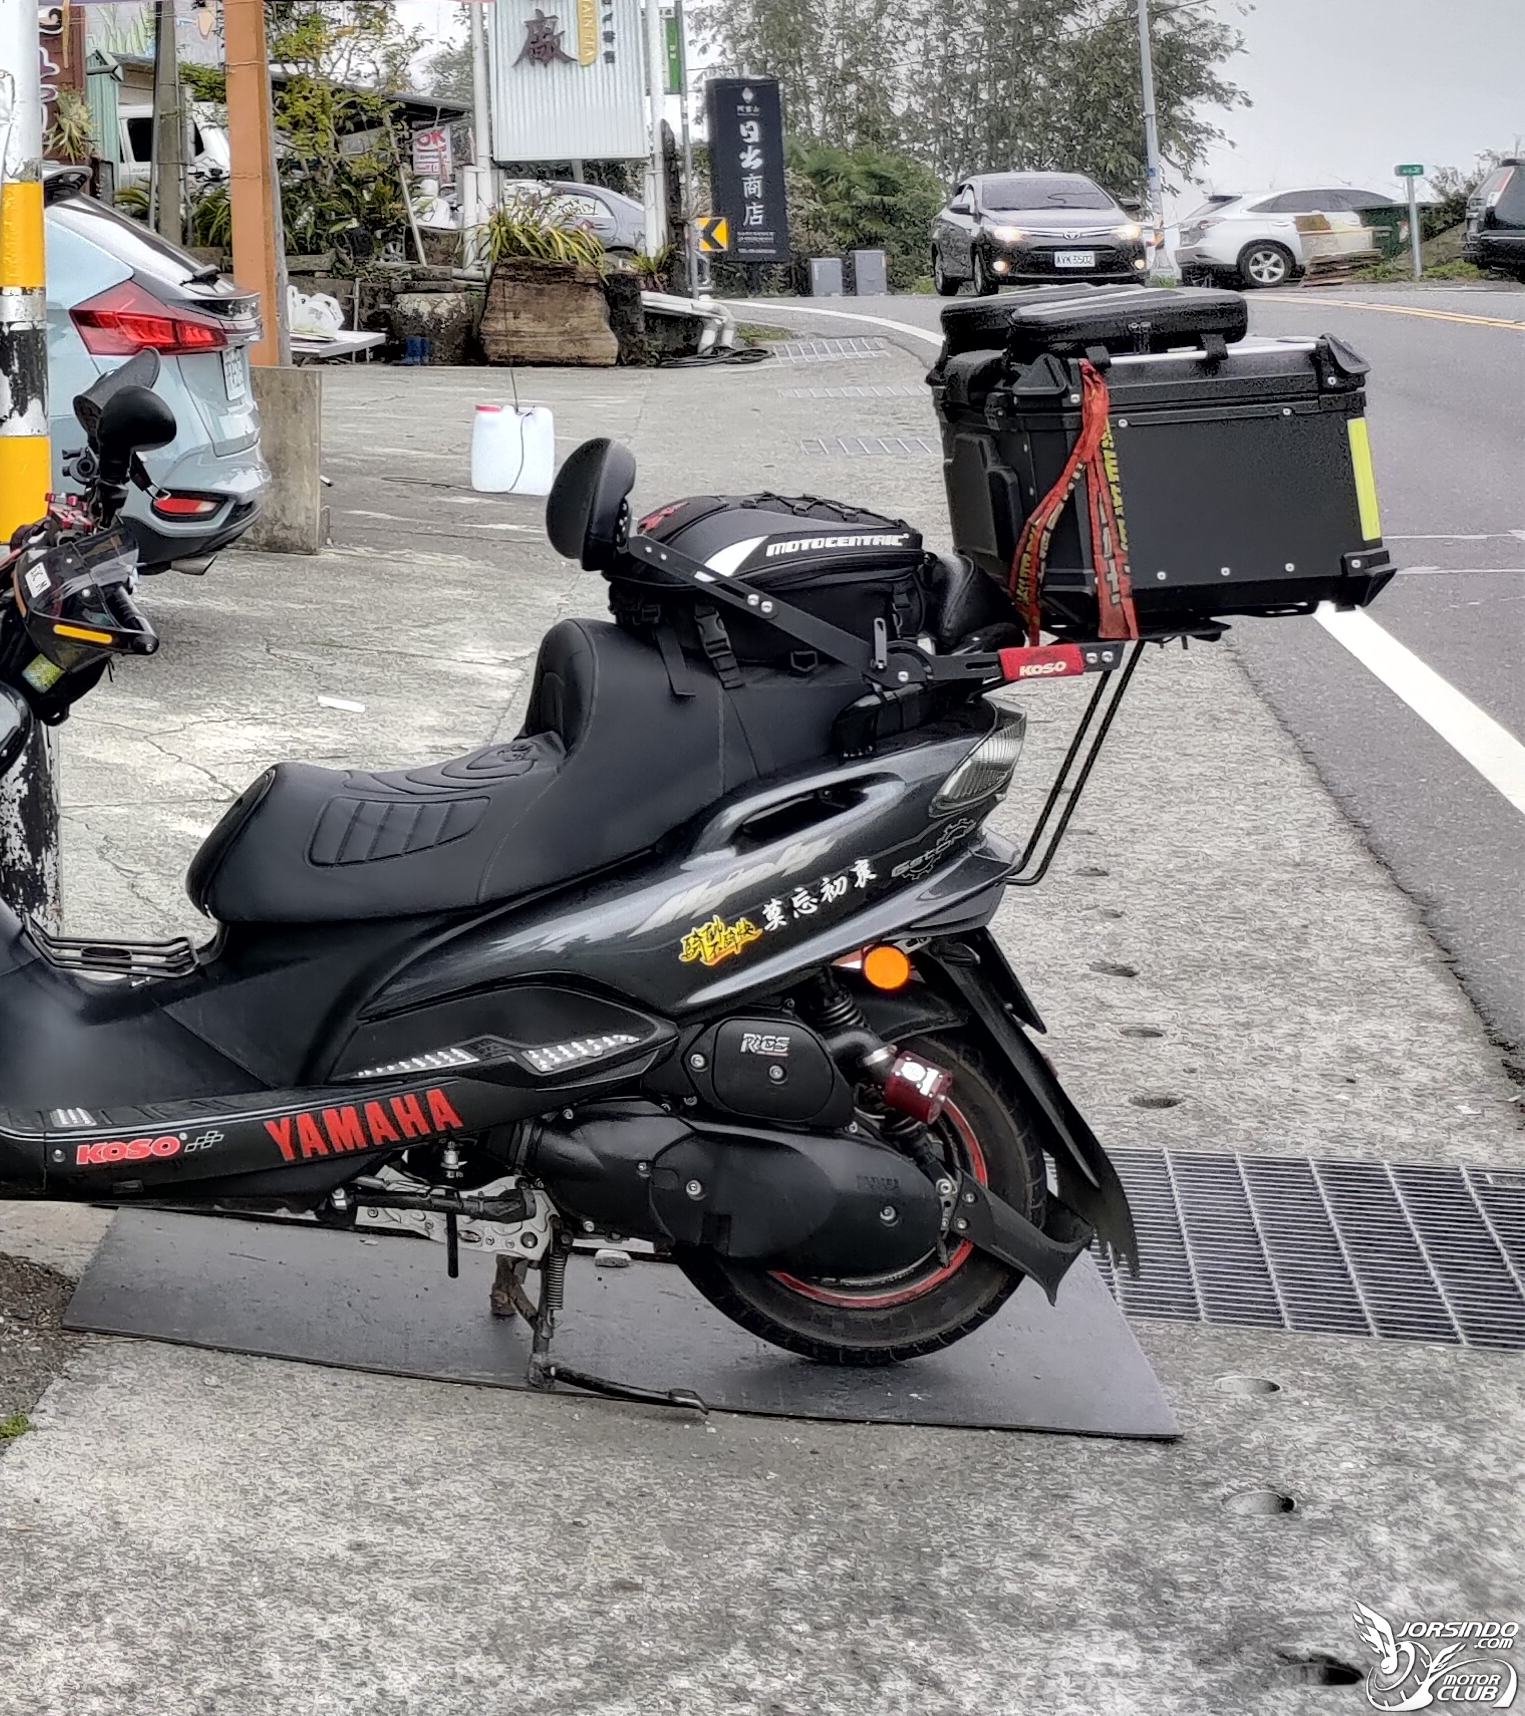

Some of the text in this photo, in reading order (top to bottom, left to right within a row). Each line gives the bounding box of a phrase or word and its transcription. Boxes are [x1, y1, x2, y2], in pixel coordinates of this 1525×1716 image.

[765, 534, 905, 558] MOTOCENTRIC
[1018, 660, 1068, 677] KOSO
[263, 1087, 463, 1162] YAMAHA
[76, 1135, 182, 1165] KOSO
